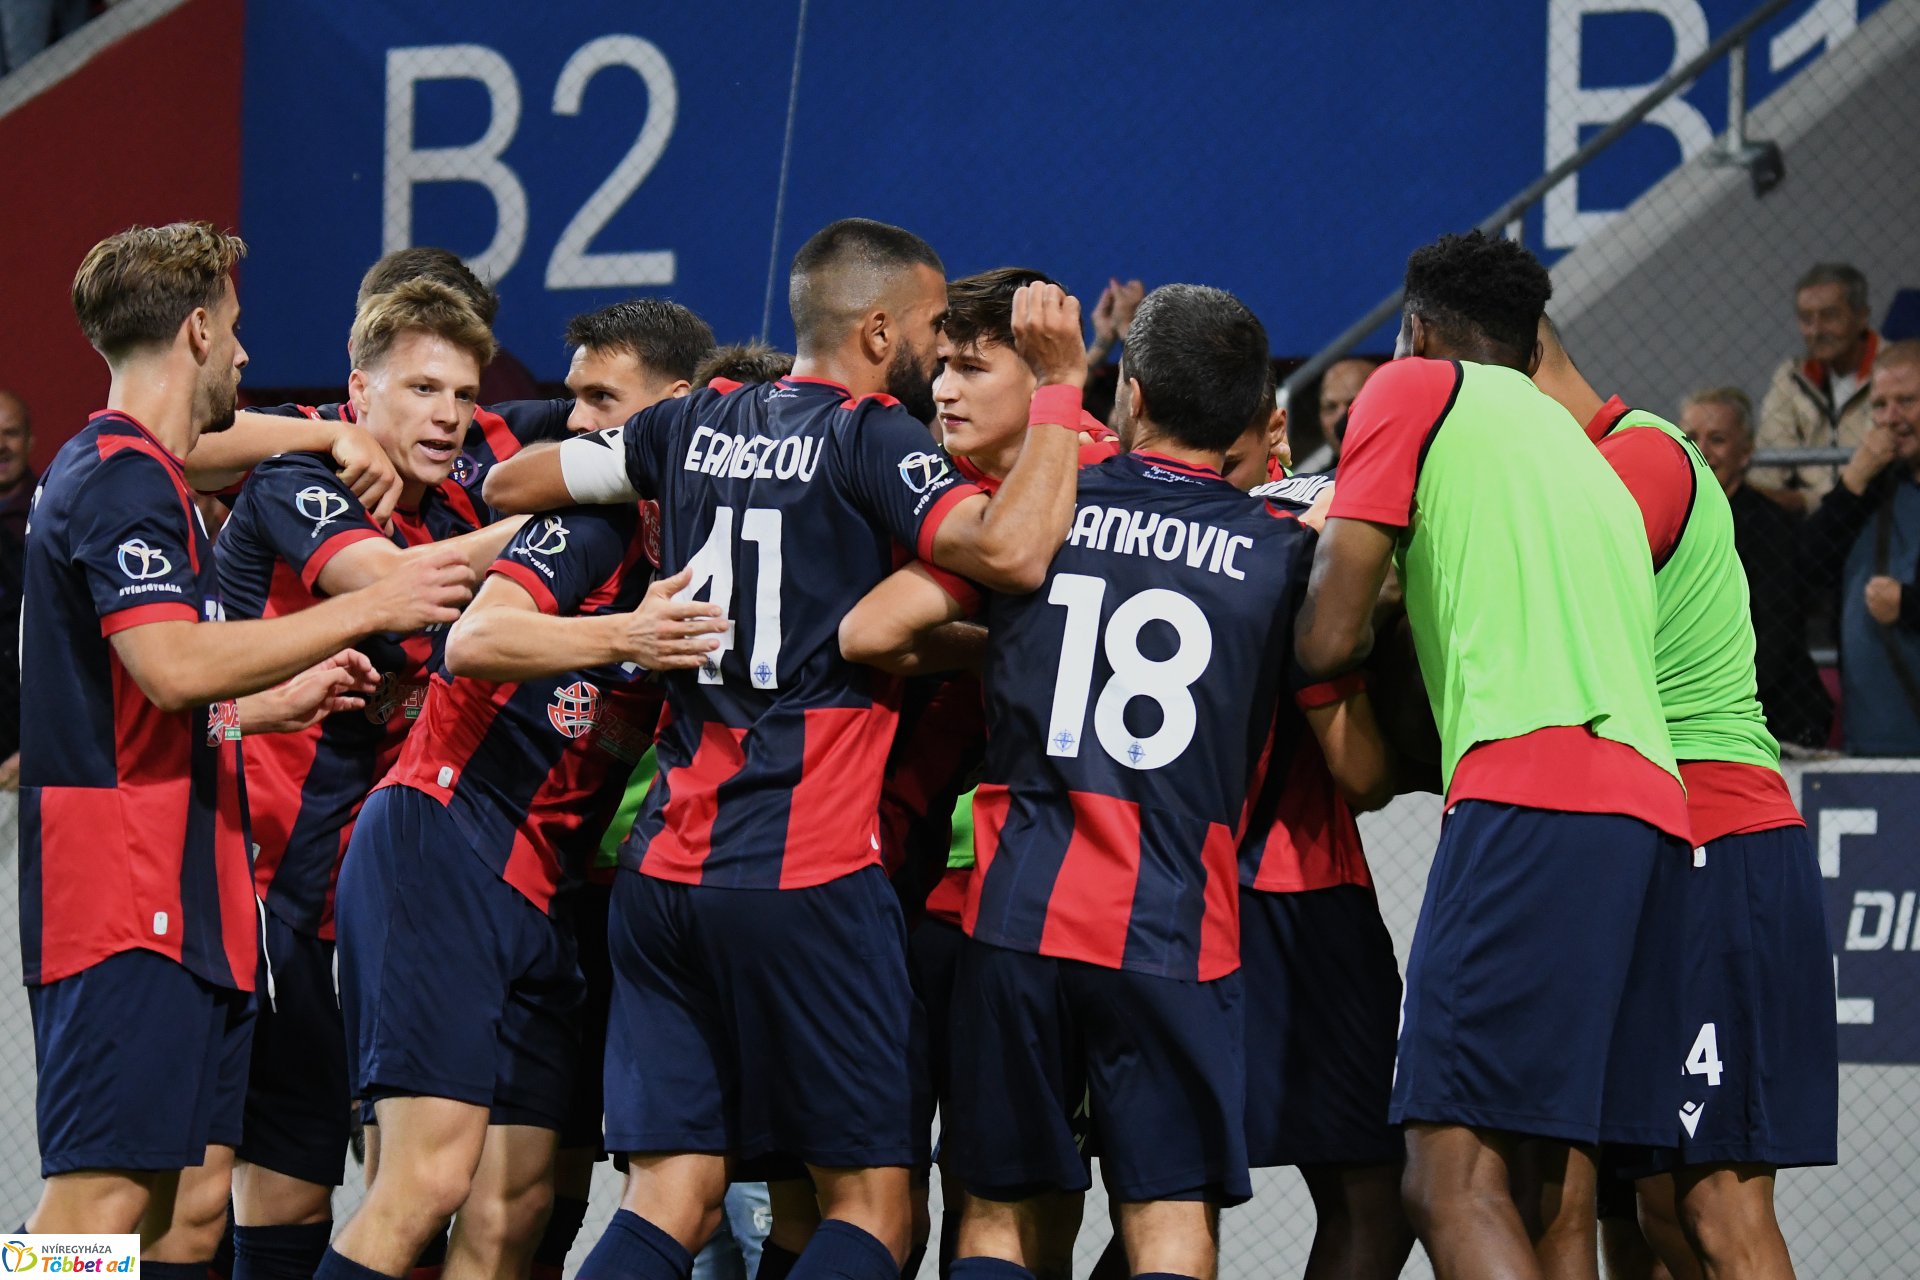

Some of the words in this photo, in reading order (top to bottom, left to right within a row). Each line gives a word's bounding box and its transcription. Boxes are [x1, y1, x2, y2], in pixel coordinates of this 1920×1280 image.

[382, 34, 680, 289] B2
[670, 506, 782, 690] 41
[1066, 503, 1254, 581] ANKOVIC
[1046, 572, 1213, 770] 18
